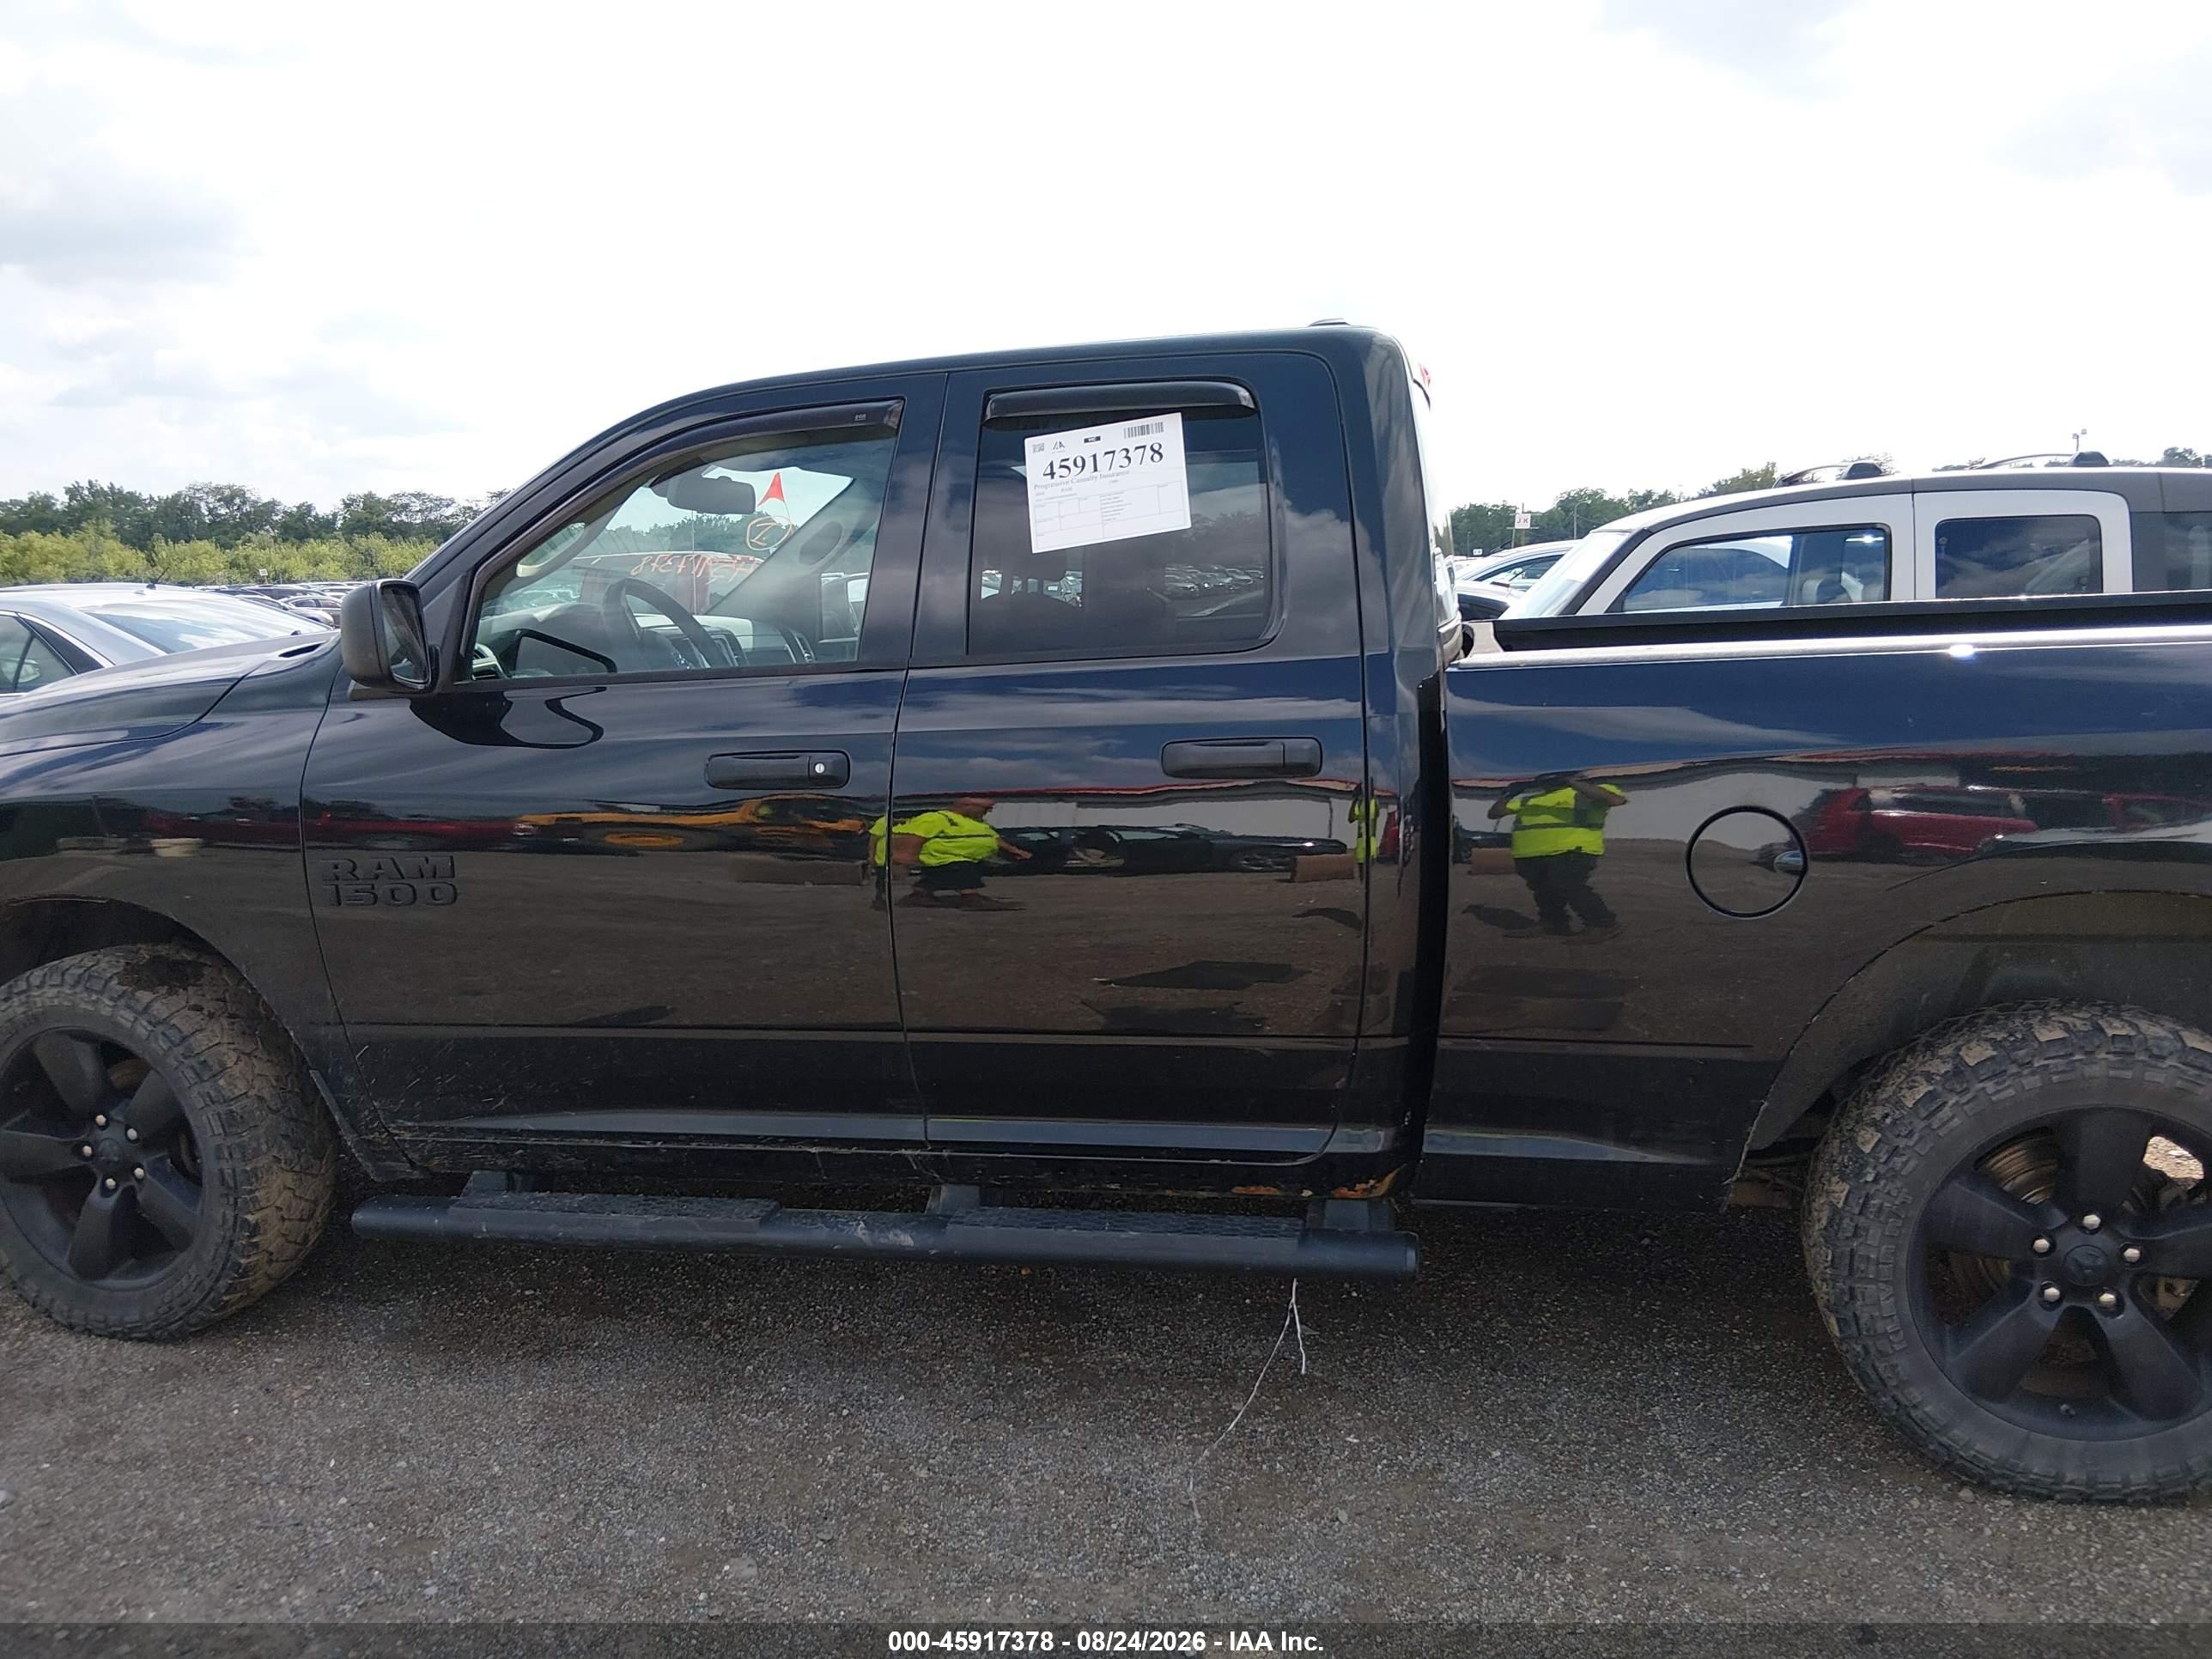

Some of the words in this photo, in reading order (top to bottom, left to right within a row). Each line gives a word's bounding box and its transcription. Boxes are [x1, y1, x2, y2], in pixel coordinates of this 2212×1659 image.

[1043, 441, 1164, 480] 45917378
[320, 855, 456, 881] RAM
[322, 881, 459, 907] 1500
